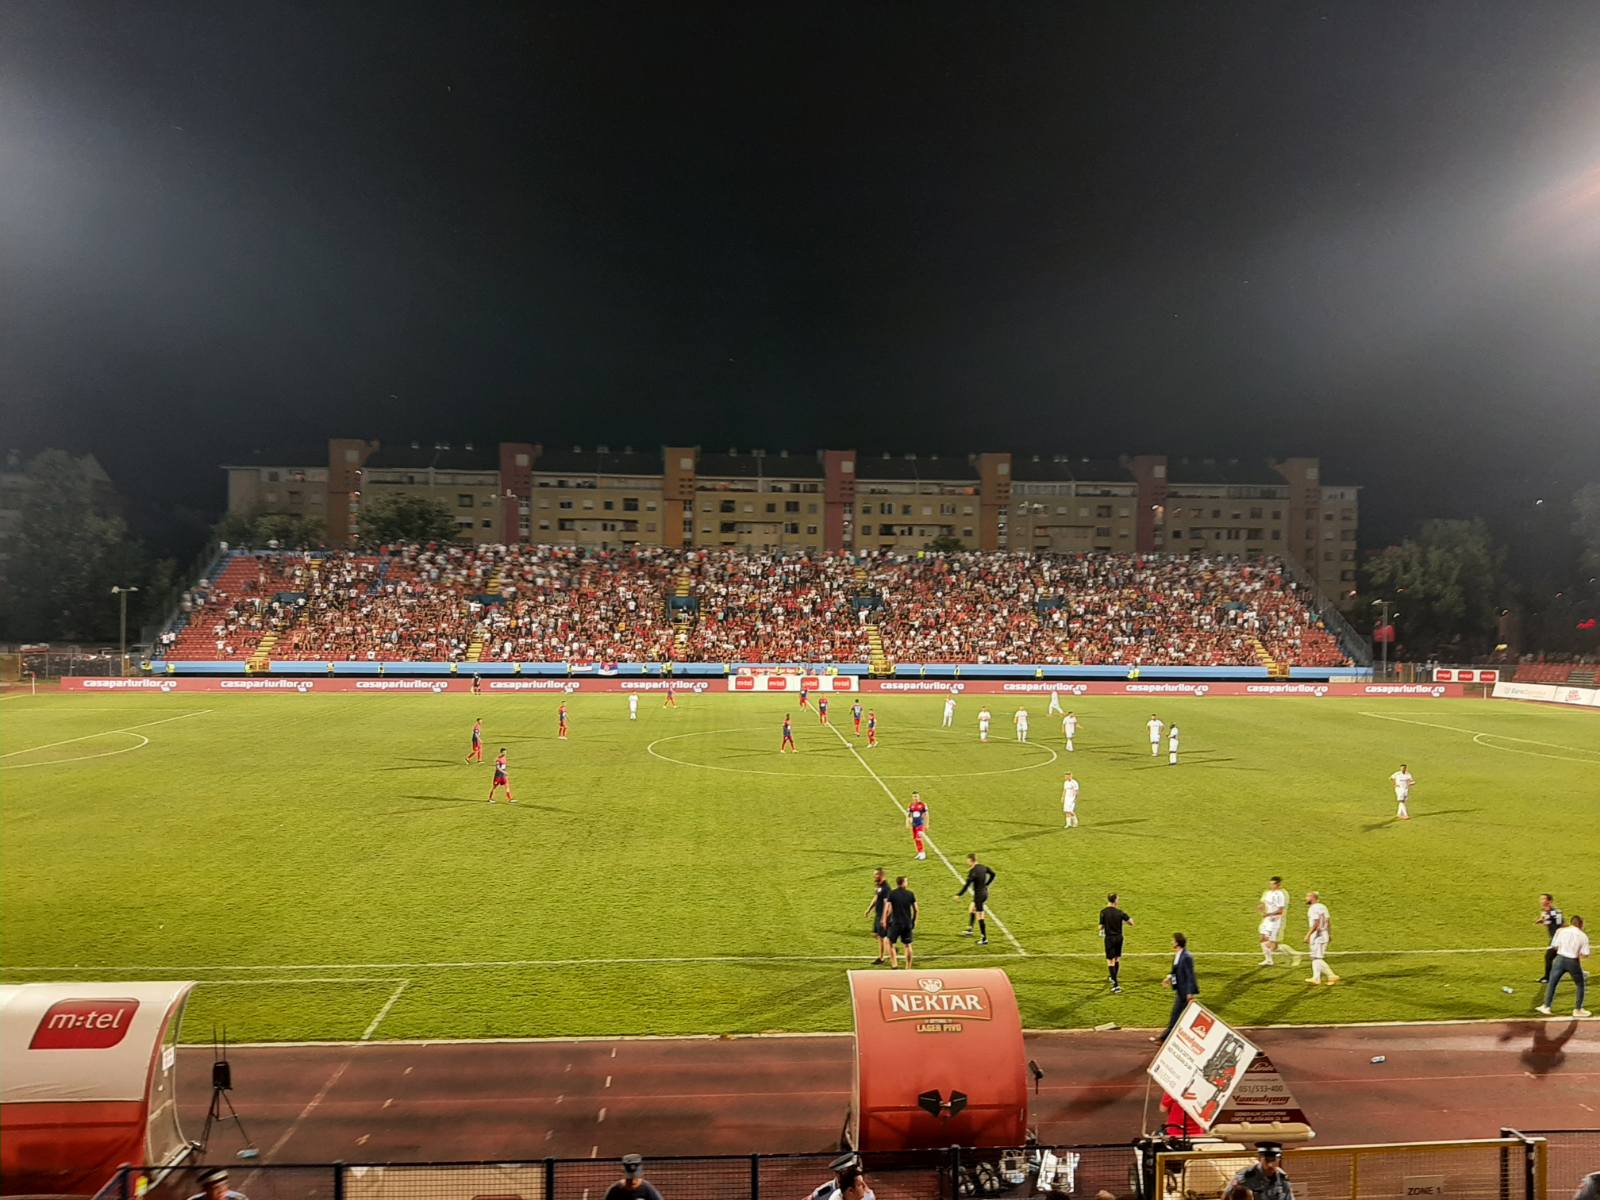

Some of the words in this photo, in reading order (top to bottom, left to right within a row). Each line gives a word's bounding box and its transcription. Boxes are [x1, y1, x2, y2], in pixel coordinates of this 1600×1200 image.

[889, 994, 983, 1012] NEKTAR
[48, 1008, 125, 1029] m:tel
[916, 1024, 942, 1033] LAGER
[943, 1023, 962, 1032] PIVO
[1407, 1187, 1434, 1196] ZONE
